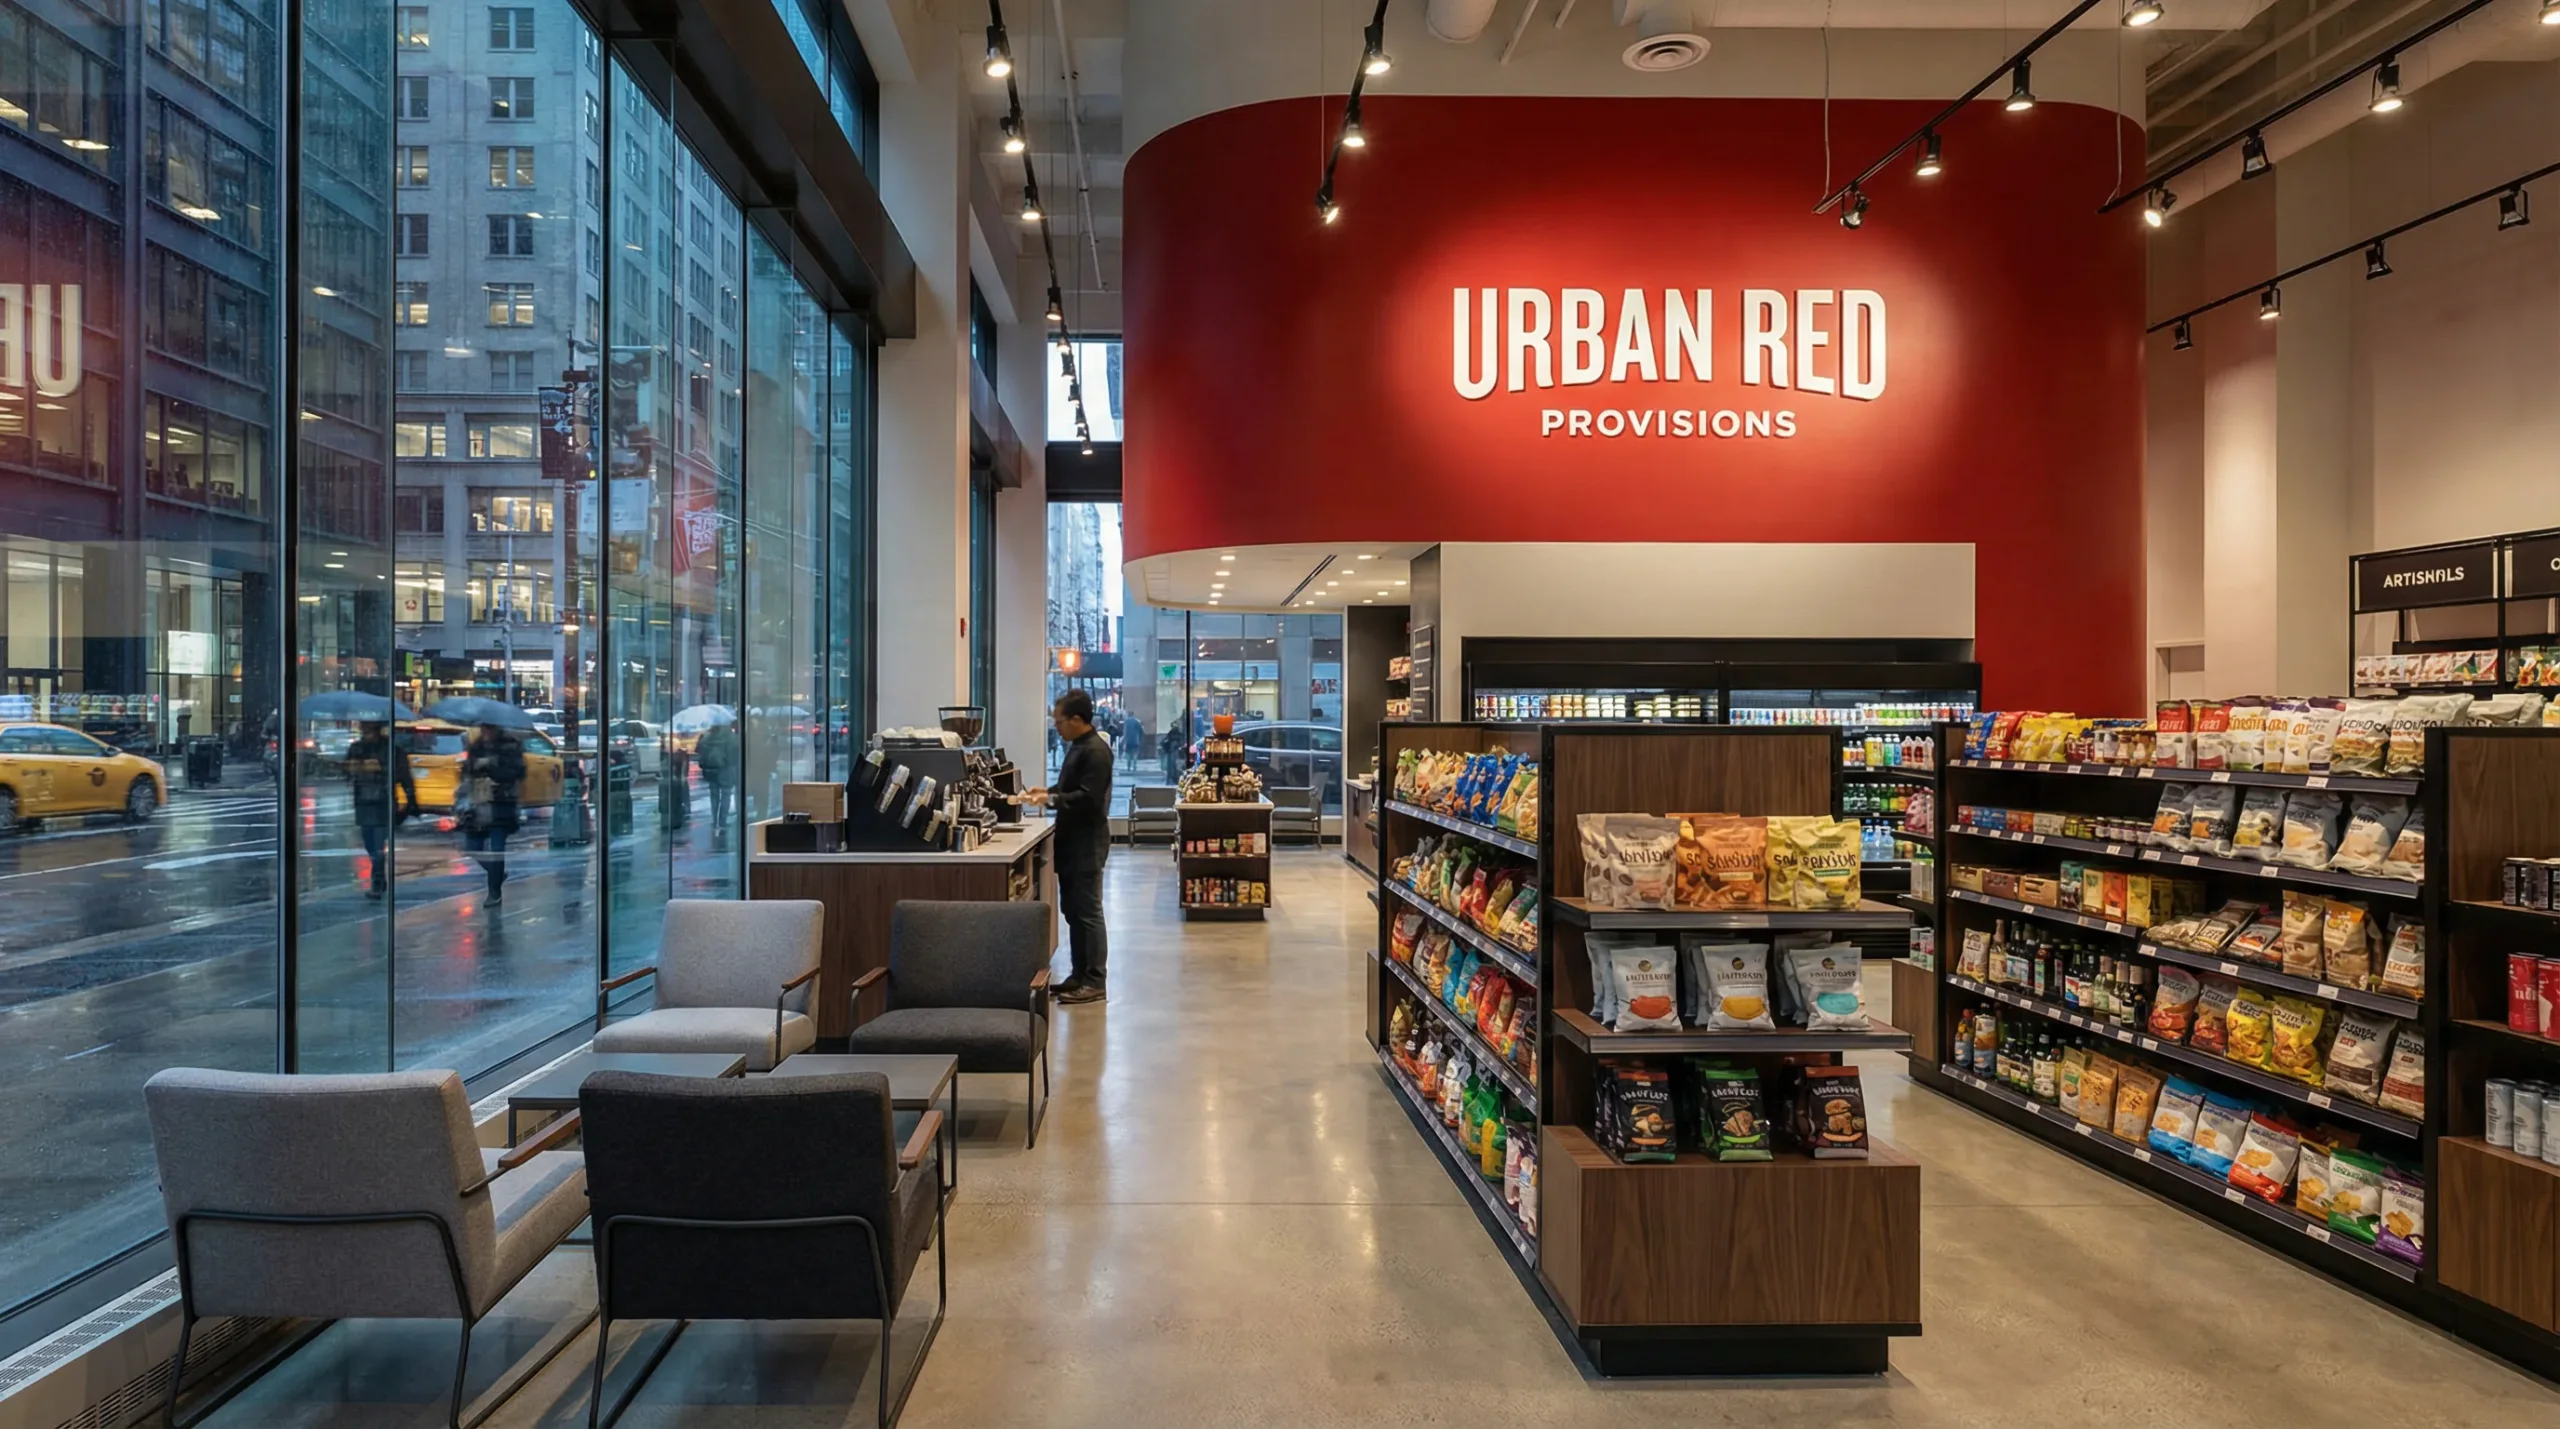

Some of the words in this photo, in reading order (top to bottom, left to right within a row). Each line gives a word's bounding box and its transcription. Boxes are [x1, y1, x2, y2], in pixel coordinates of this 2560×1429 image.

[1453, 287, 1713, 400] URBAN
[1742, 288, 1887, 401] RED
[1541, 408, 1798, 437] PROVISIONS
